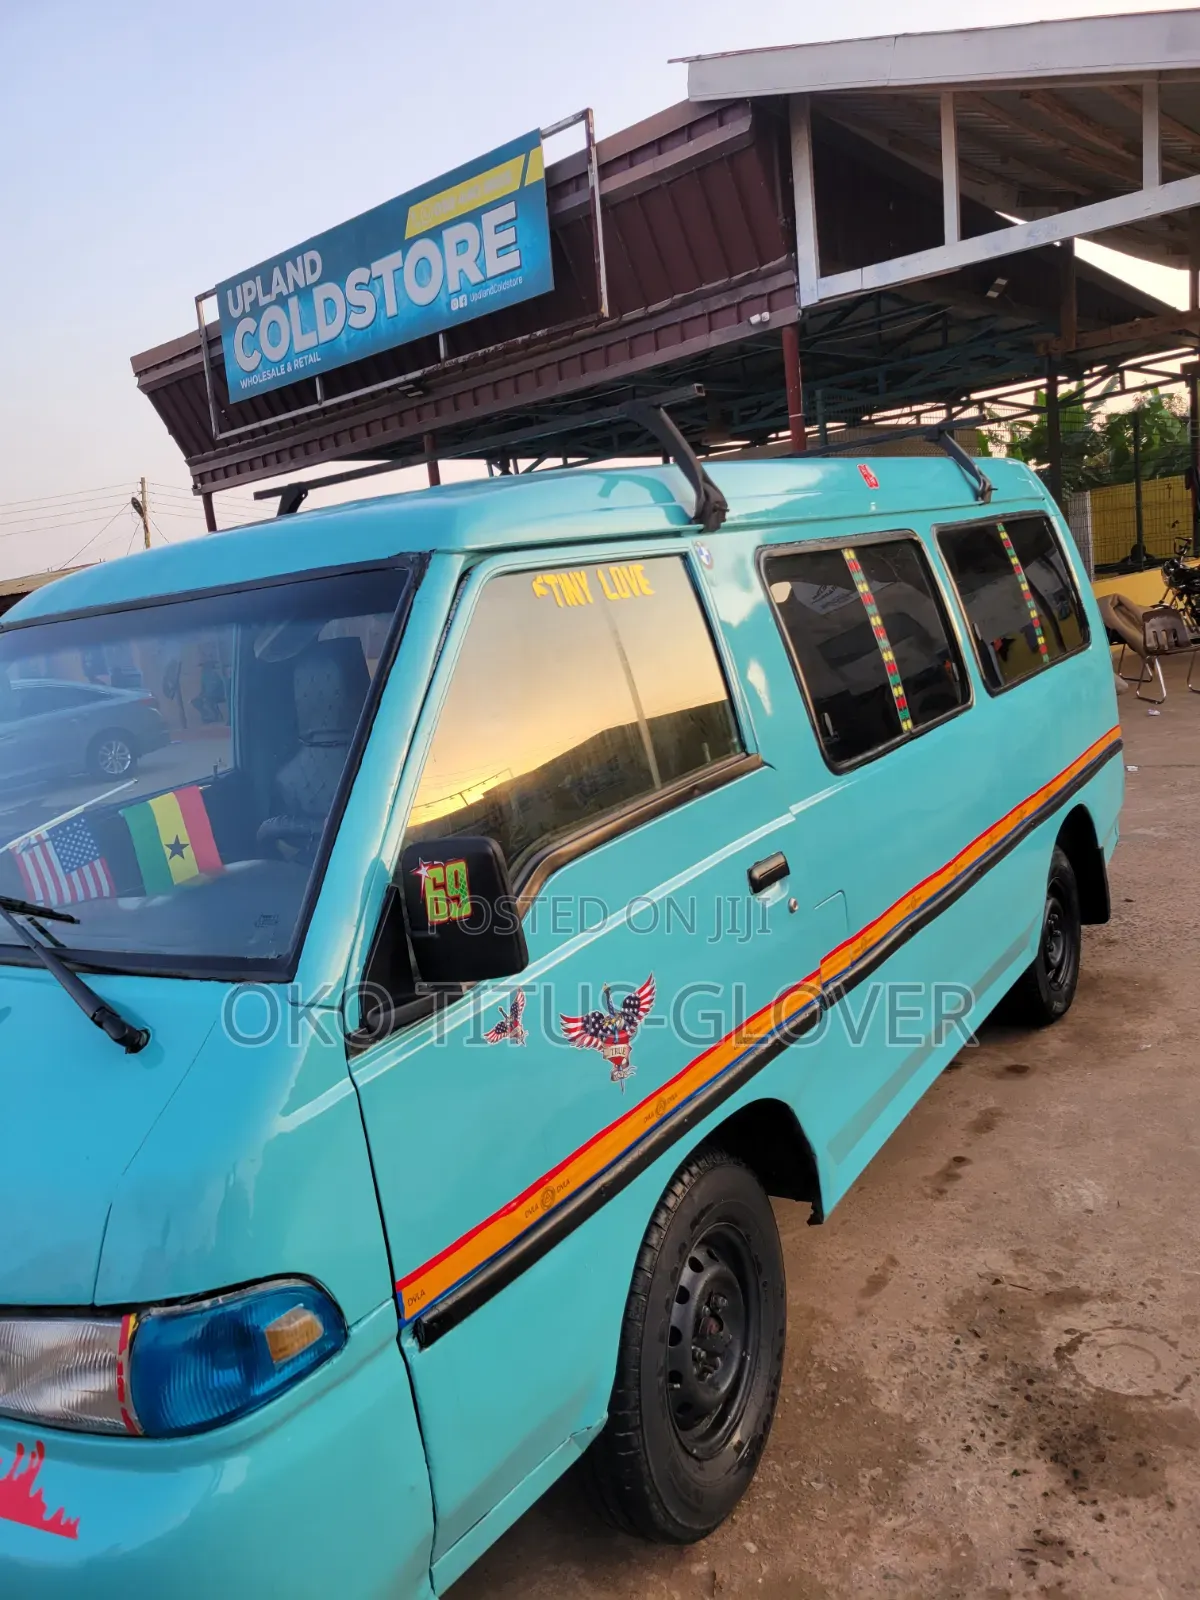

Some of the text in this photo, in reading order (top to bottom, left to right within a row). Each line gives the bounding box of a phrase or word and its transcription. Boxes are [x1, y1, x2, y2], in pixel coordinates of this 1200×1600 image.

[227, 250, 322, 318] UPLAND
[234, 201, 522, 372] COLDSTORE
[240, 352, 321, 389] WHOLESALE & RETAIL
[597, 564, 655, 600] LOVE
[425, 860, 471, 924] 69
[407, 1289, 426, 1307] DVLA
